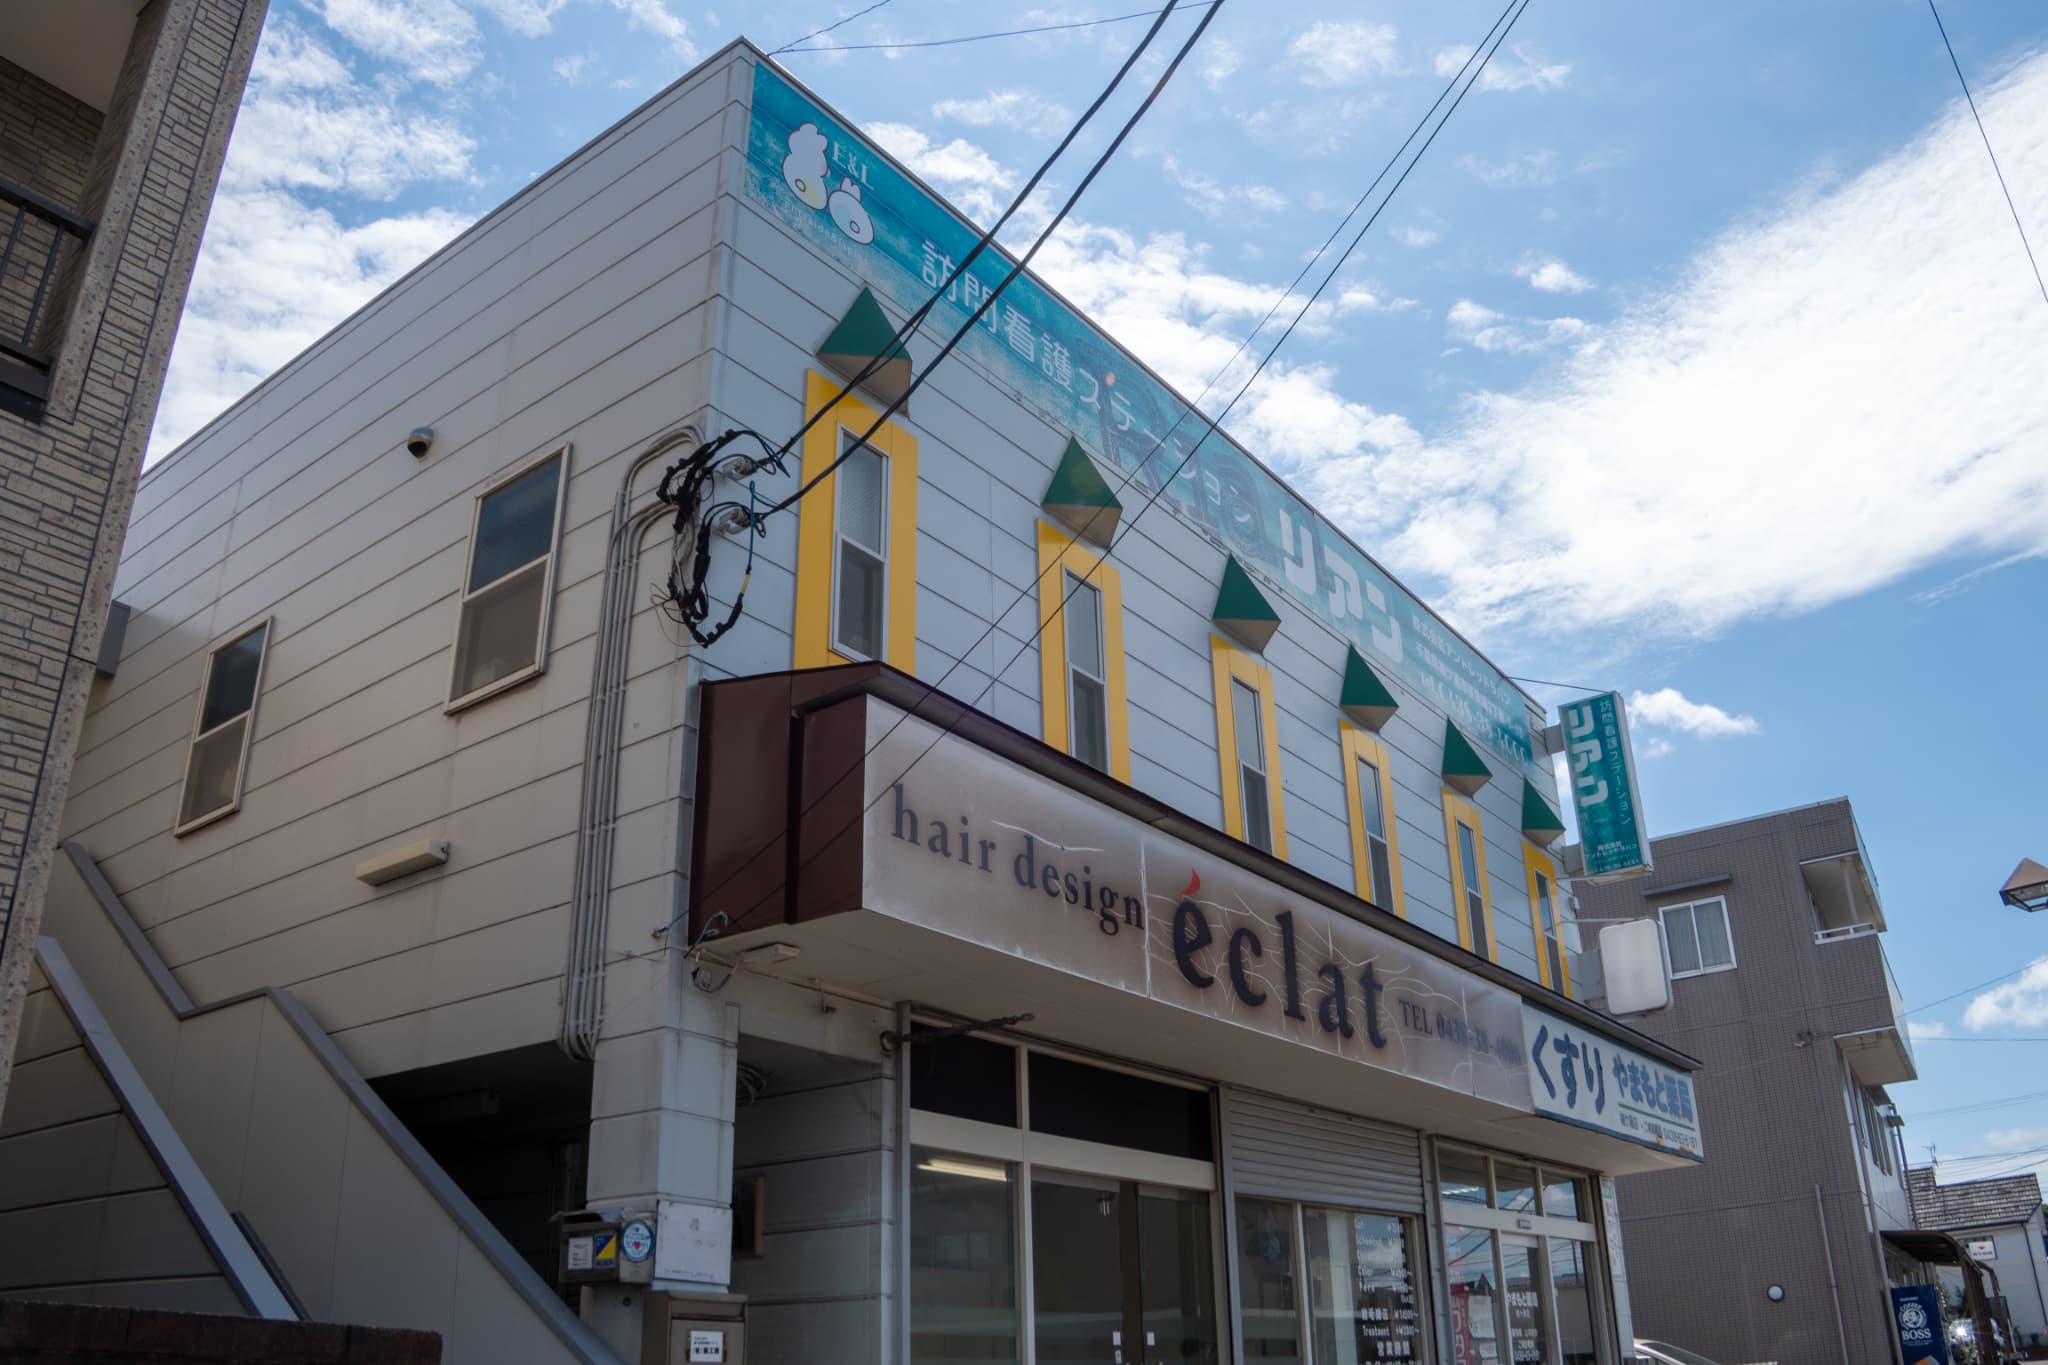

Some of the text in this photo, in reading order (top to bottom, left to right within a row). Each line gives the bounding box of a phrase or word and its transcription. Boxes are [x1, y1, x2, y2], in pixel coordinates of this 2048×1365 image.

[921, 239, 1404, 664] 訪問看護ステーション リアン
[1567, 704, 1609, 808] リアン
[1599, 700, 1632, 825] 訪問看護ステーション
[890, 783, 1145, 936] hair design
[1399, 1000, 1433, 1036] TEL
[1532, 1024, 1606, 1116] くすり
[1612, 1053, 1694, 1124] やまもと薬局
[1901, 1328, 1932, 1341] BOSS
